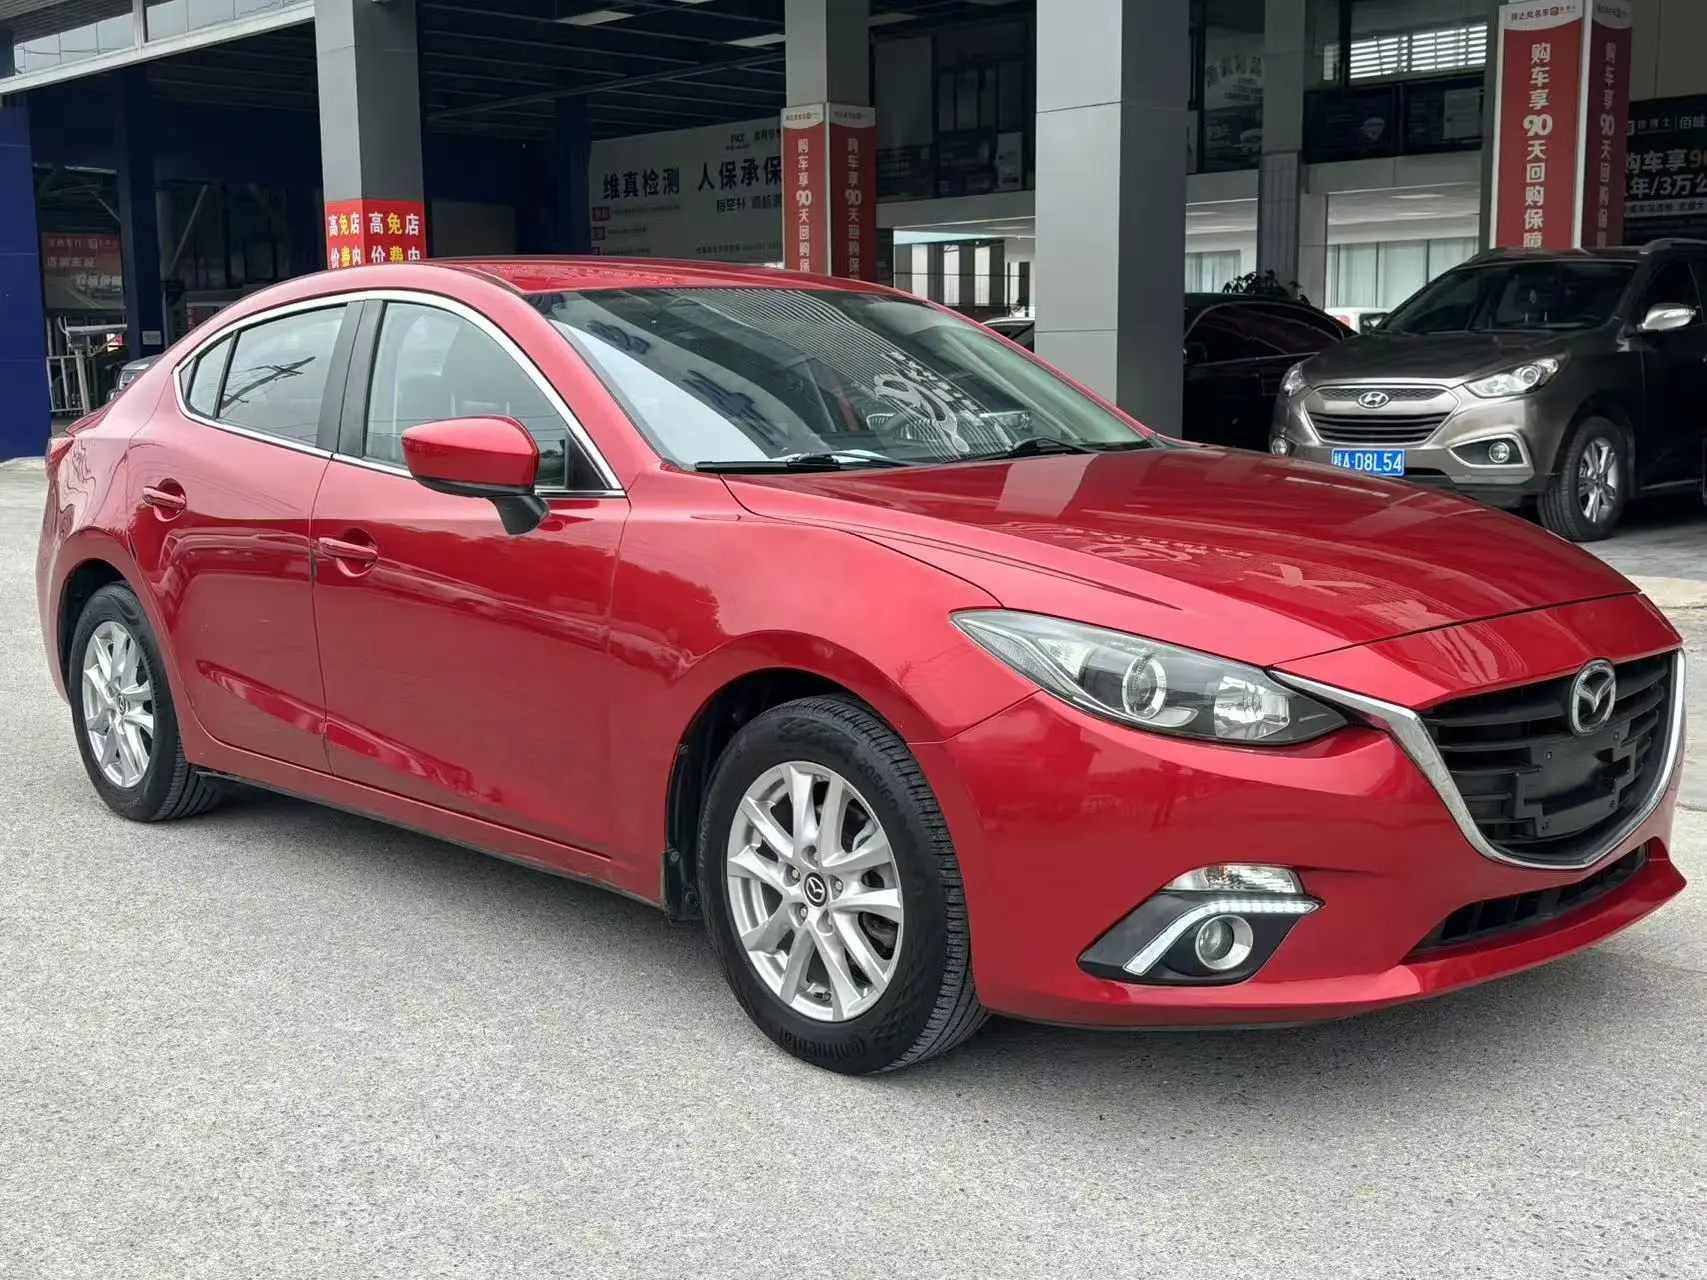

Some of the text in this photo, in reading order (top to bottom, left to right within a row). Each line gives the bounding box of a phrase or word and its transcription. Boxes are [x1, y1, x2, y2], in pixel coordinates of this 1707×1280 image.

[603, 167, 680, 200] 维真检测
[845, 137, 862, 279] 购车享90天回购保
[1522, 42, 1553, 248] 购车享90天回购保障
